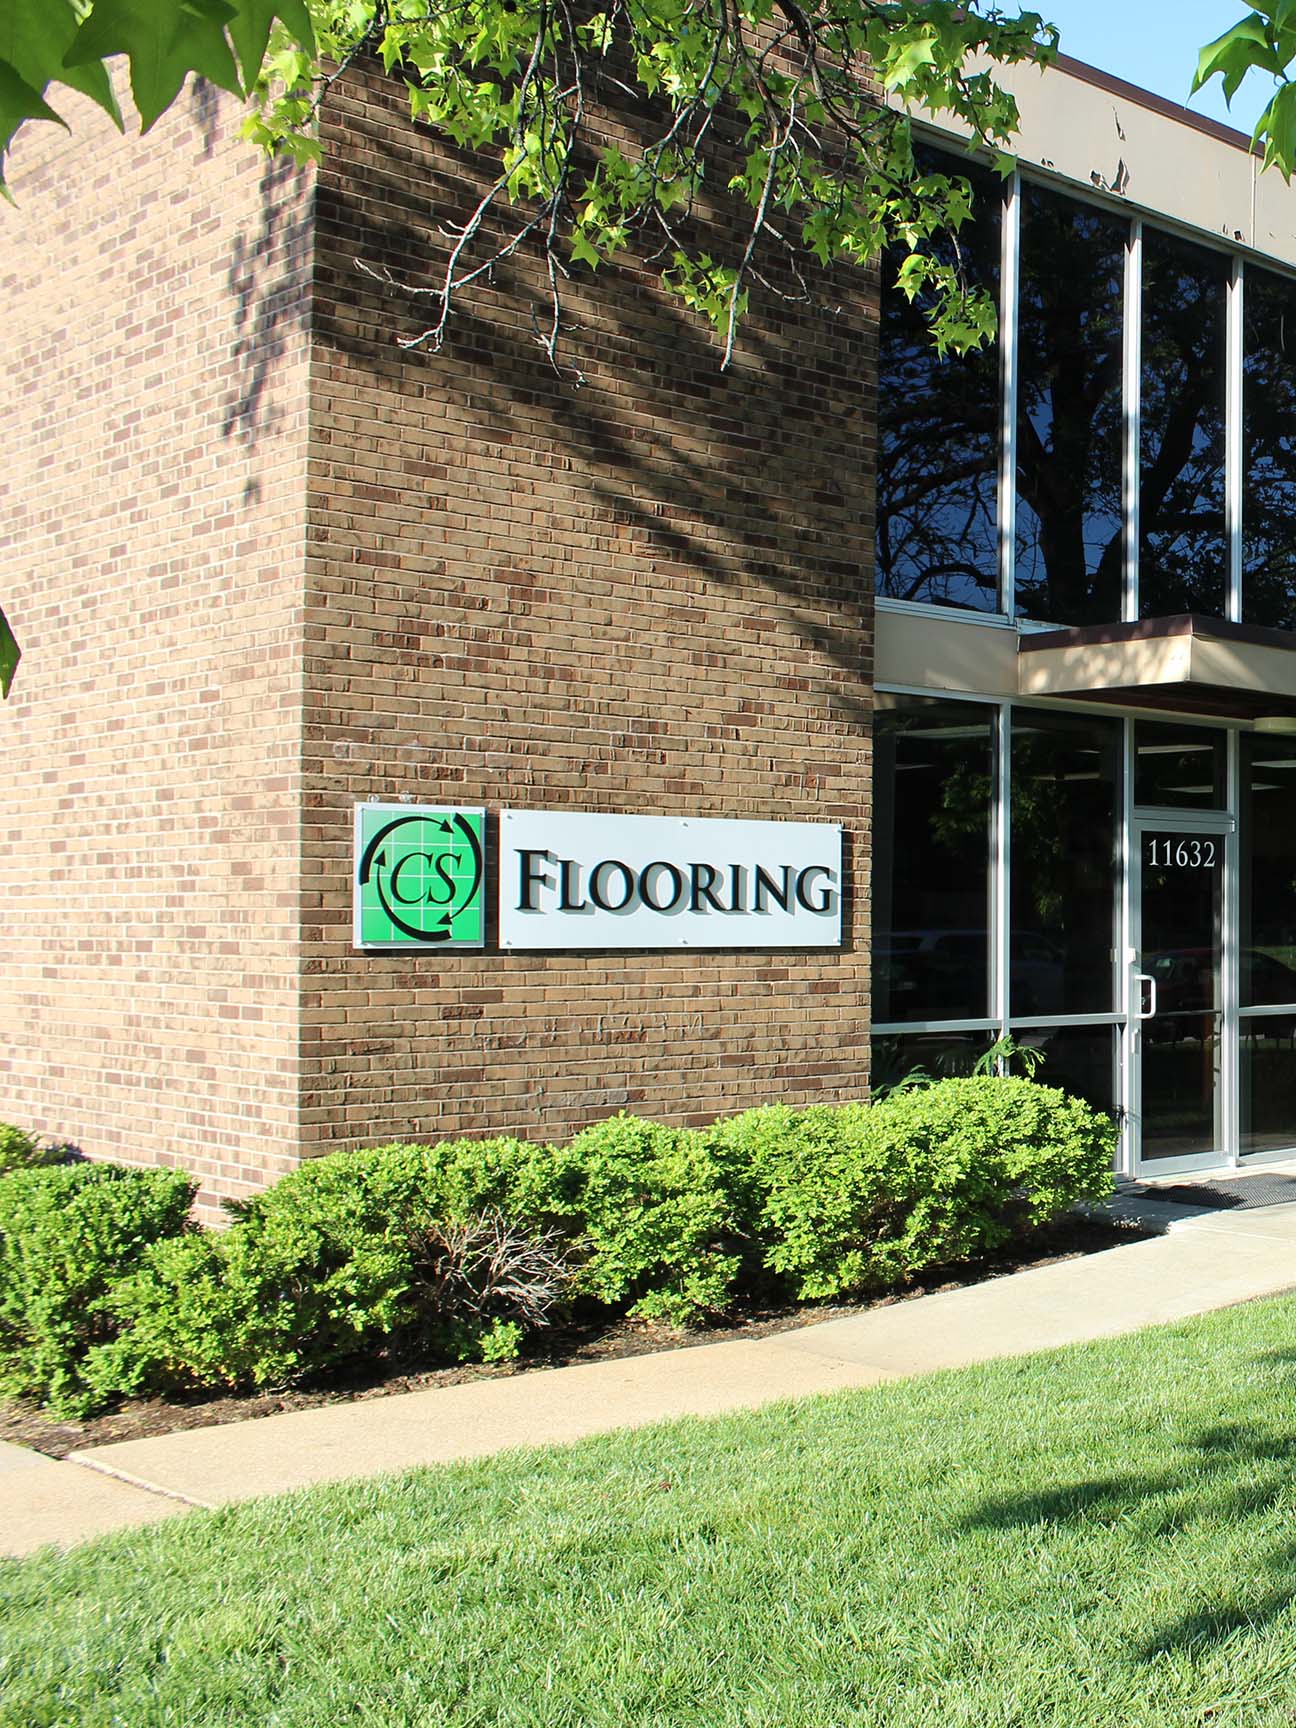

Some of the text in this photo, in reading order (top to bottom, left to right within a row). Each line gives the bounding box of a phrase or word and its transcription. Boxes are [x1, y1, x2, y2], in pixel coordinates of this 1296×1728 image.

[1148, 839, 1216, 867] 11632
[390, 848, 834, 913] CS FLOORING
